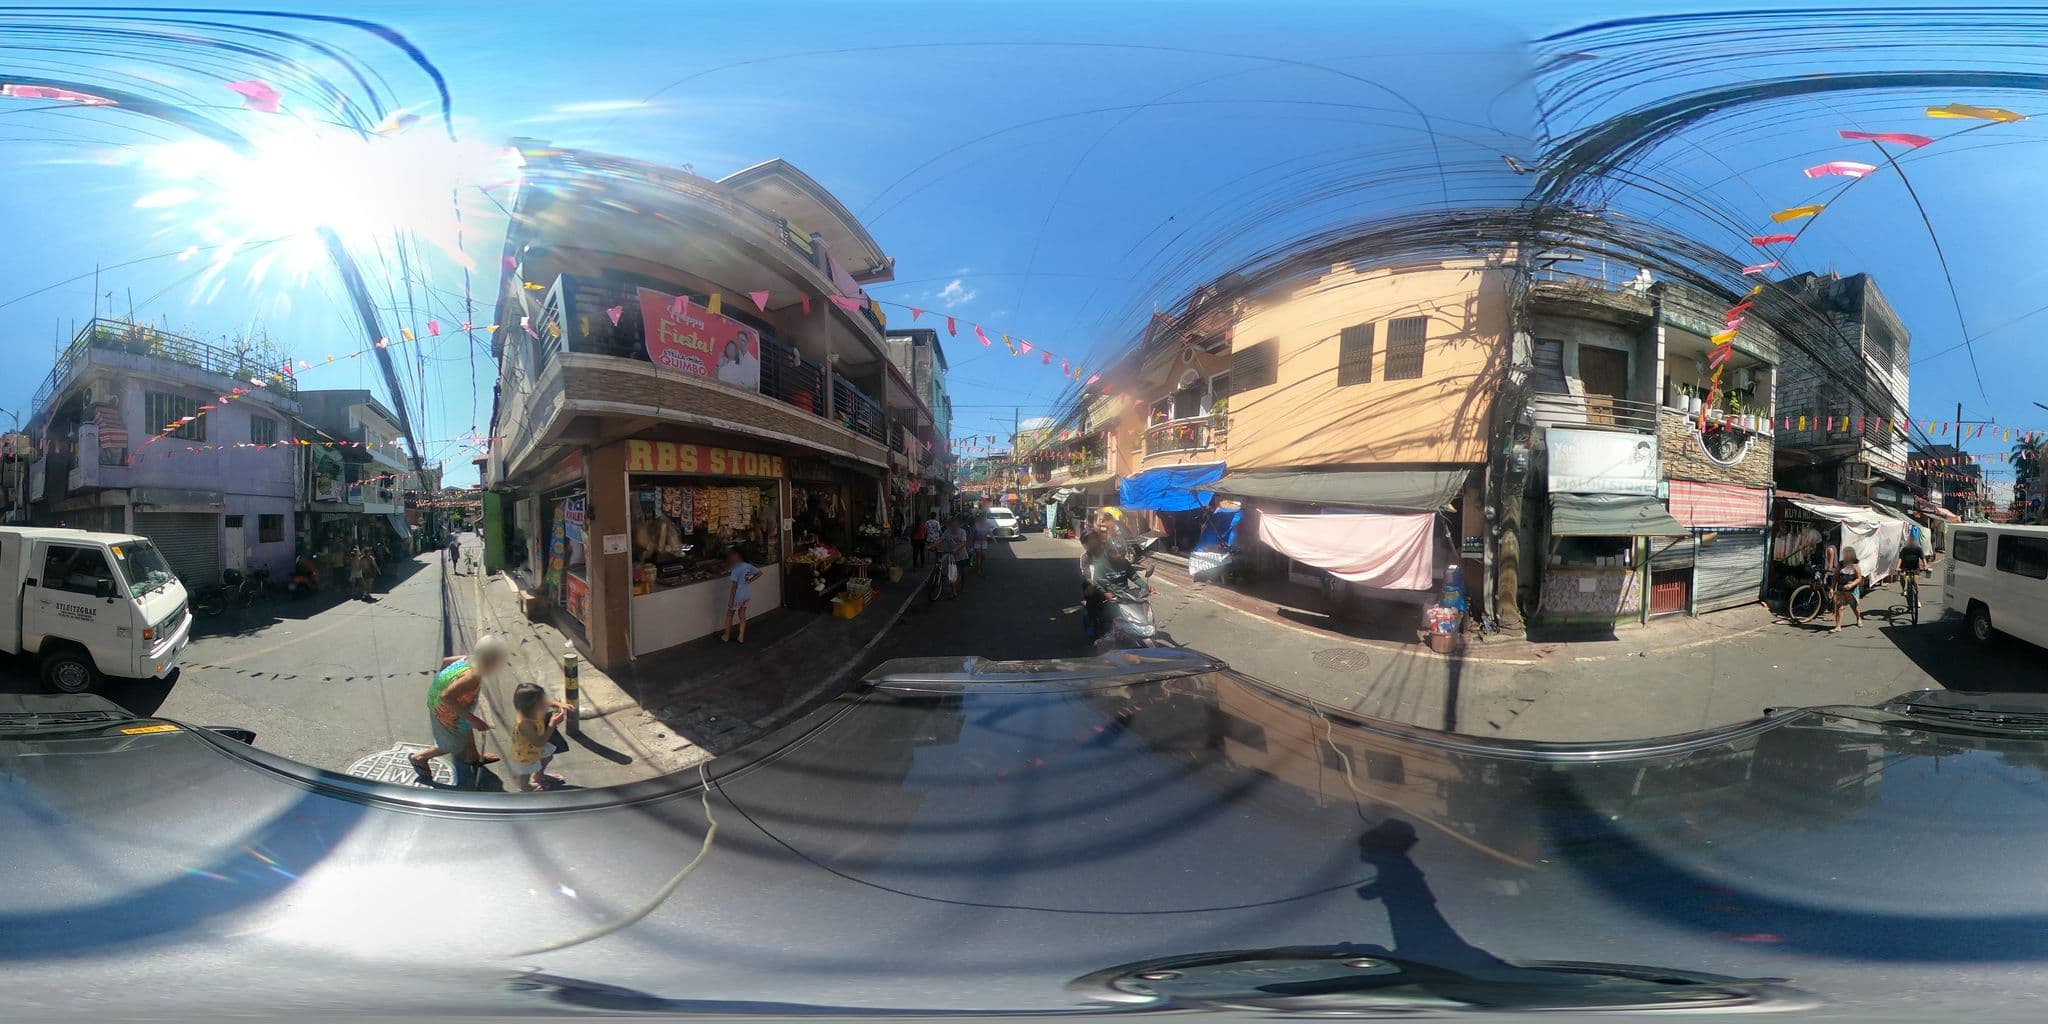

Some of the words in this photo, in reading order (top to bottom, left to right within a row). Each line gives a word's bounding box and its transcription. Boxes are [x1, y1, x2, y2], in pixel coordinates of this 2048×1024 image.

[657, 318, 715, 355] Fiesta!
[661, 355, 706, 376] QUIMBO
[630, 440, 697, 472] RBS
[710, 448, 784, 477] STORE
